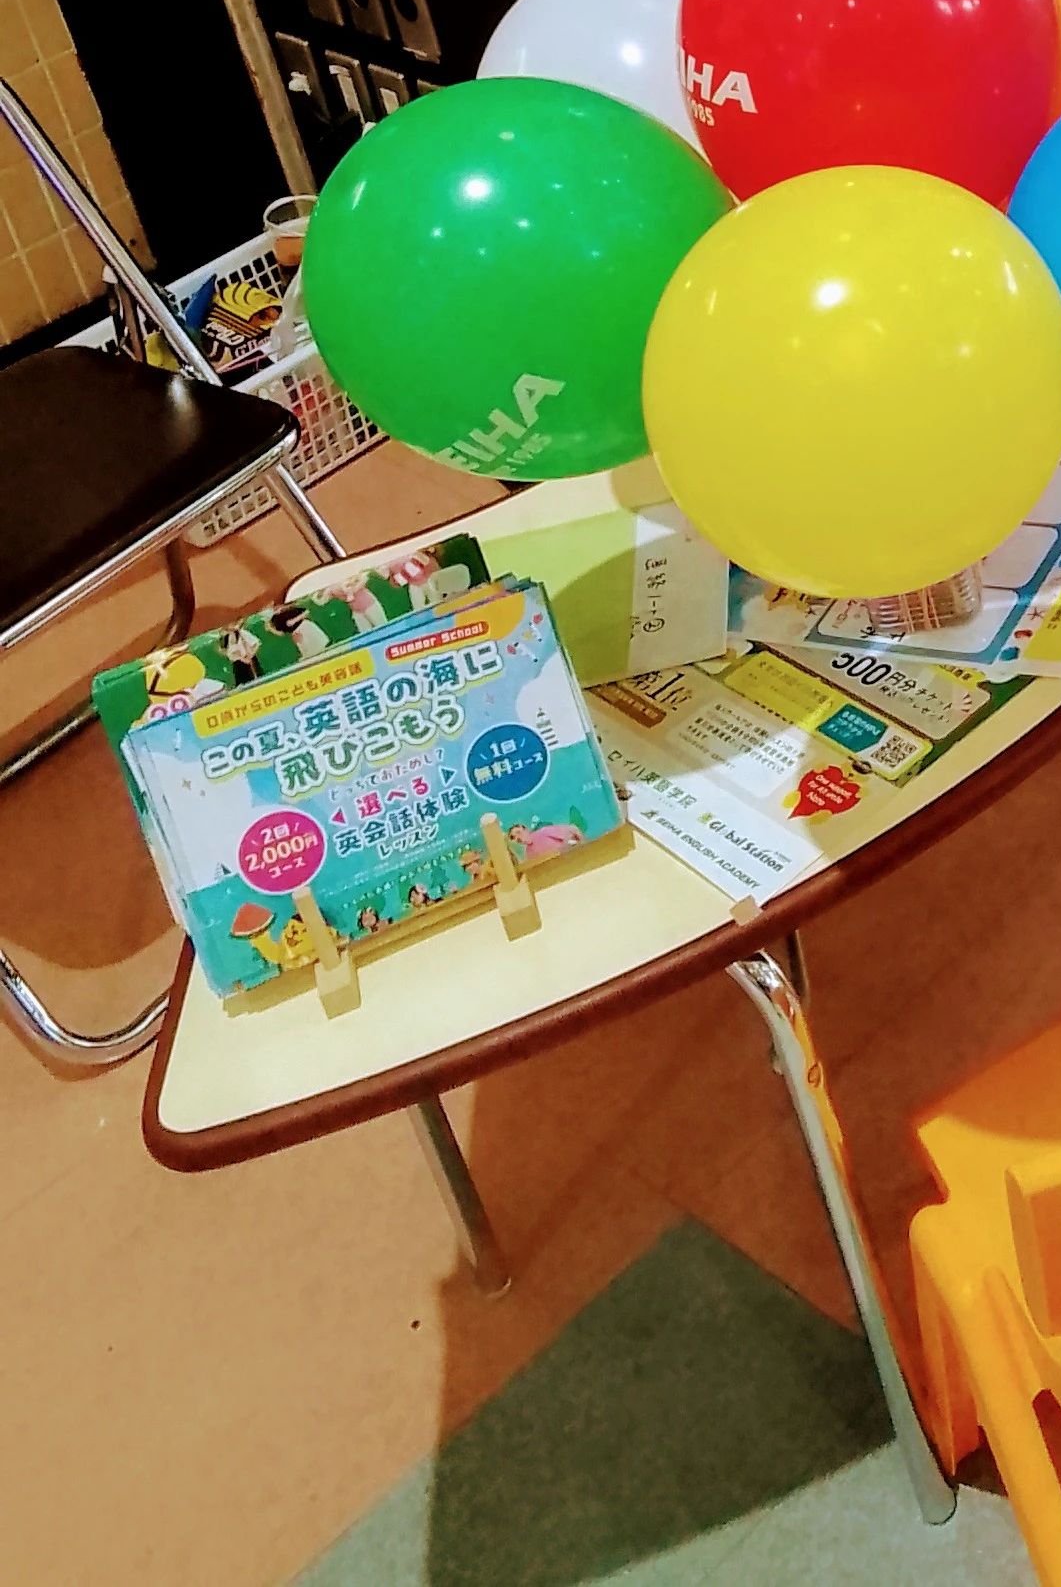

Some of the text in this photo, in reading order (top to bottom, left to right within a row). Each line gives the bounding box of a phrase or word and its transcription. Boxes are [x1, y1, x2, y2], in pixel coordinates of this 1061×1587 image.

[441, 622, 484, 645] School
[205, 645, 499, 774] この夏、英語の海に
[280, 696, 462, 791] 飛びこもう
[356, 776, 430, 818] 選べる
[337, 787, 468, 853] 英会話体験
[378, 823, 439, 859] レッスン
[268, 856, 306, 879] コース
